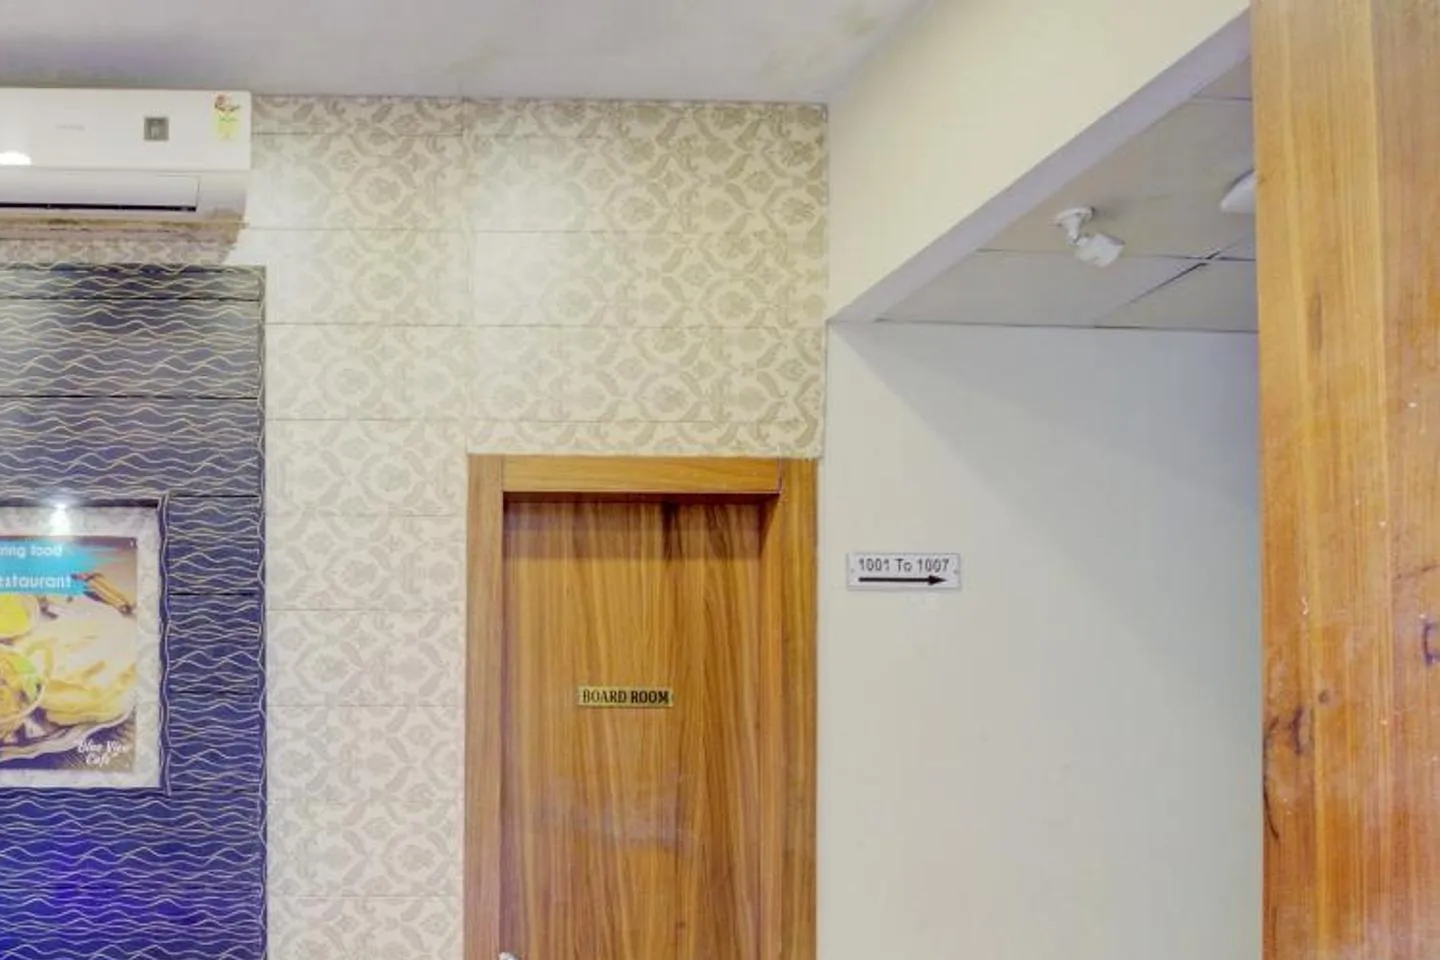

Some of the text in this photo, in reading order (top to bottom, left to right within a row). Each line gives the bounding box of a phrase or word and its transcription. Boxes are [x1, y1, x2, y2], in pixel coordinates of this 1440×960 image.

[859, 558, 950, 572] 1001 To 1007
[583, 689, 669, 704] BOARD ROOM
